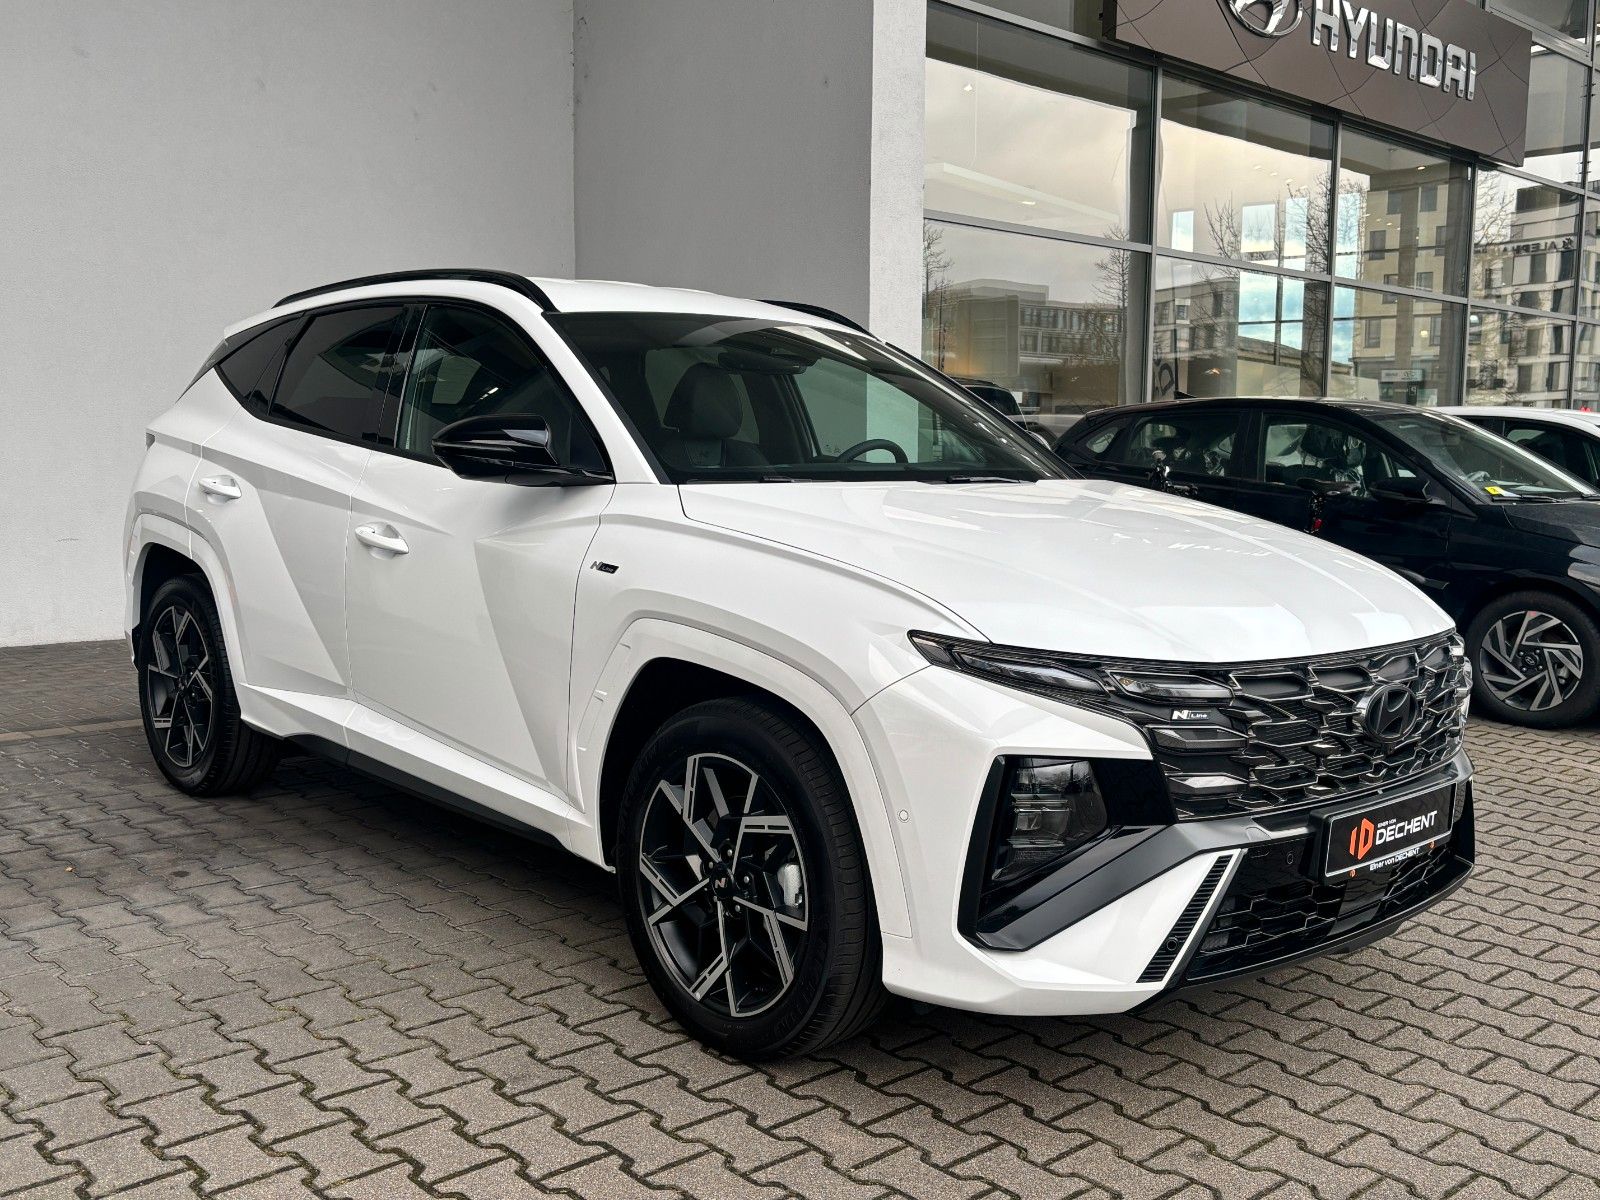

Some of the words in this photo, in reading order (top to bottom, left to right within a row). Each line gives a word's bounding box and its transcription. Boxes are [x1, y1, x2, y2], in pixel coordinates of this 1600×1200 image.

[1312, 0, 1476, 100] HYUNDAI
[1171, 709, 1190, 720] N
[1375, 810, 1438, 846] DECHENT
[1369, 860, 1384, 871] Einer
[1385, 857, 1395, 866] von
[1395, 848, 1420, 863] DECHENT
